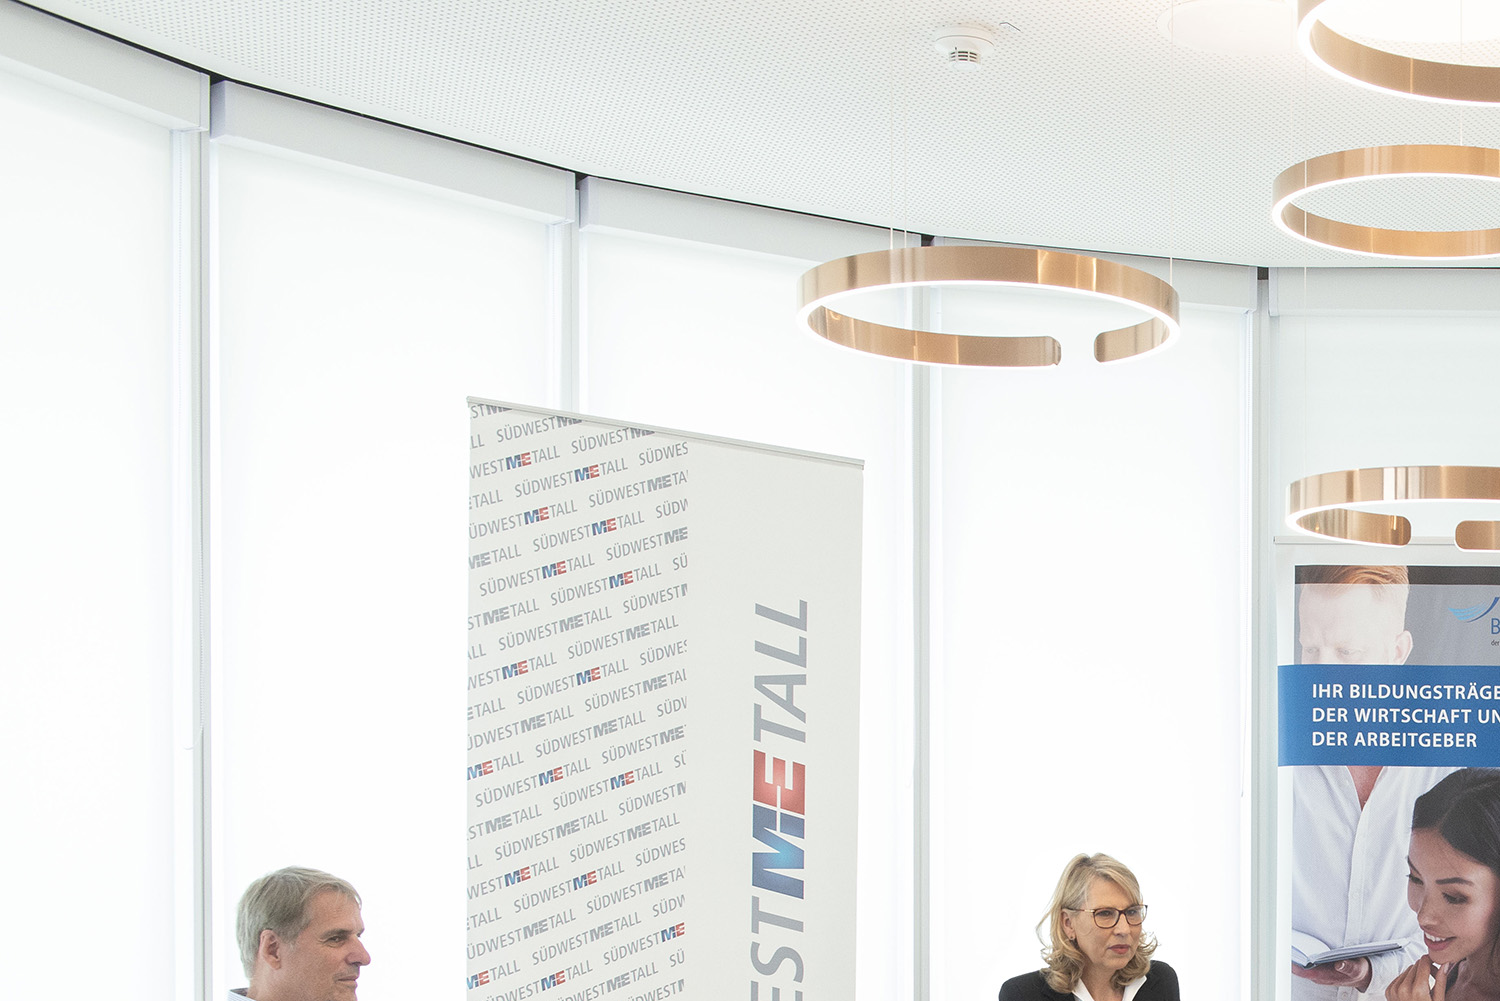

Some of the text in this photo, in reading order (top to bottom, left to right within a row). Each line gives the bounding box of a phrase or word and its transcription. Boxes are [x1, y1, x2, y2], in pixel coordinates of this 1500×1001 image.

[469, 490, 503, 509] TALL
[515, 458, 628, 497] SÜDWESTMETALL
[589, 470, 688, 508] SÜDWESTMETA
[533, 511, 644, 552] SÜDWESTMETALL
[480, 554, 595, 596] SÜDWESTMETALL
[551, 564, 662, 606] SÜDWESTMETALL
[499, 607, 612, 650] SÜDWESTMETALL
[568, 616, 678, 659] SÜDWESTMETALL
[518, 659, 629, 704] SÜDWESTMETALL
[1313, 684, 1342, 698] IHR
[536, 711, 646, 758] SÜDWESTMETALL
[1313, 708, 1347, 722] DER
[1354, 708, 1471, 723] WIRTSCHAFT
[1313, 732, 1476, 747] DER ARBEITGEBER
[476, 724, 686, 807] SÜDWESTMETALL SÜDWESTME
[467, 804, 542, 840] STMETALL
[553, 762, 662, 810] SÜDWESTMETALL
[495, 810, 608, 860] SÜDWESTMETALL
[570, 813, 680, 862] SÜDWESTMETALL
[467, 908, 502, 930] TALL
[514, 861, 624, 913] SÜDWESTMETALL
[587, 866, 685, 914] SÜDWESTMETA
[532, 912, 641, 965] SÜDWESTMETALL
